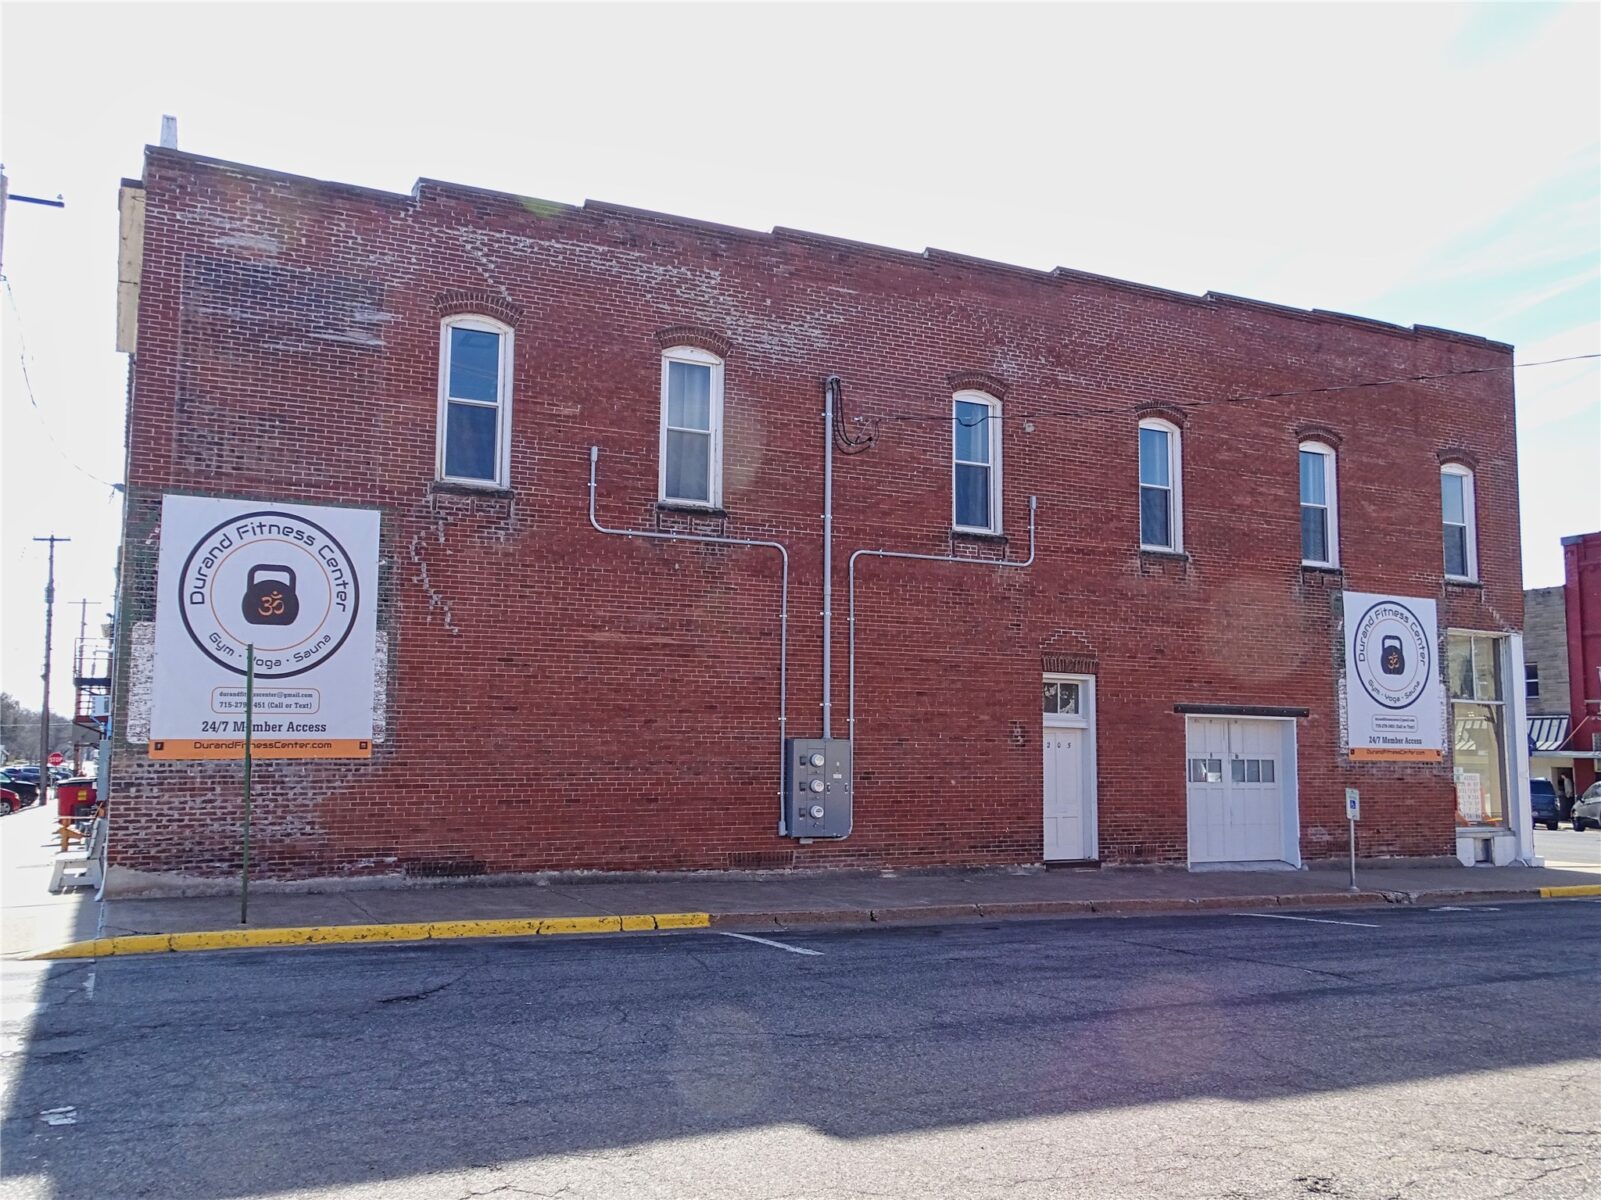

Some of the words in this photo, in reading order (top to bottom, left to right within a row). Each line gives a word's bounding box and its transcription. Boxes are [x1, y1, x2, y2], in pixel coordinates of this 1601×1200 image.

[190, 533, 233, 605] Durand
[236, 521, 315, 547] Fitness
[318, 545, 347, 613] Center
[1359, 615, 1375, 662] Durand
[1374, 607, 1409, 624] Fitness
[1409, 621, 1426, 667] Center
[208, 632, 235, 658] Gym
[247, 655, 282, 669] oga
[292, 634, 332, 663] Sauna
[1384, 693, 1401, 704] Yoga
[294, 702, 313, 710] Text)
[202, 720, 229, 733] 24/7
[233, 721, 283, 733] Mmber
[286, 721, 327, 733] Access
[193, 741, 332, 750] DurandFinessCenter.com
[1368, 735, 1381, 744] 24/7
[1382, 736, 1404, 745] Member
